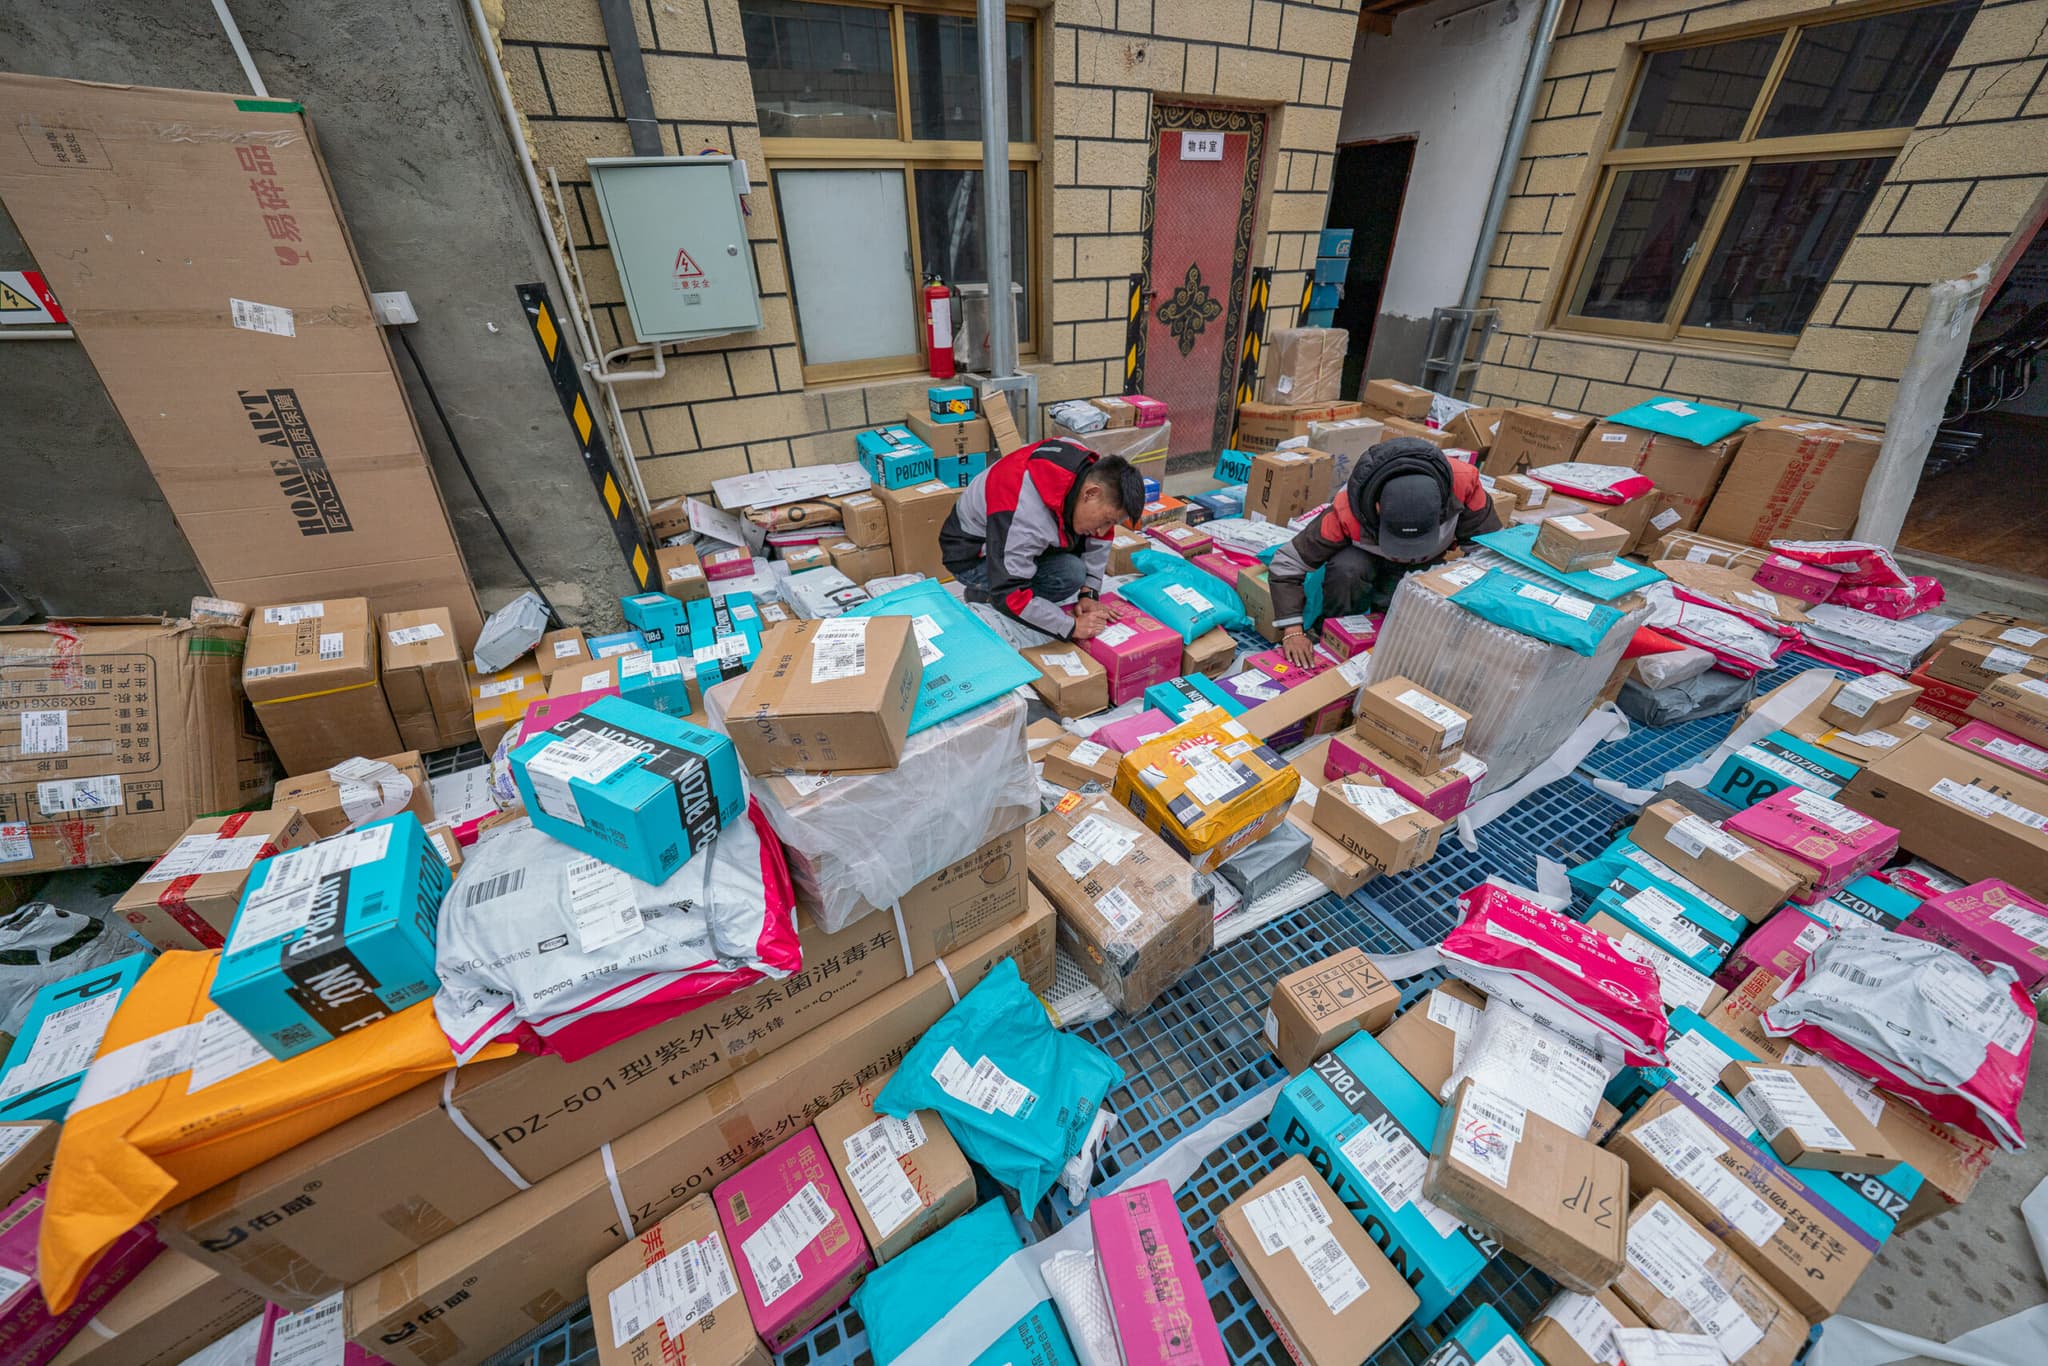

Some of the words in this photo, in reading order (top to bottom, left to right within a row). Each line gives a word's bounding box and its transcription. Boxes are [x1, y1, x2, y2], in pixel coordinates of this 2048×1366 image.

[1187, 139, 1217, 154] 物料室
[236, 144, 298, 242] 易碎品
[237, 389, 291, 452] ART
[271, 458, 327, 537] HOME
[1339, 833, 1388, 873] PLANET
